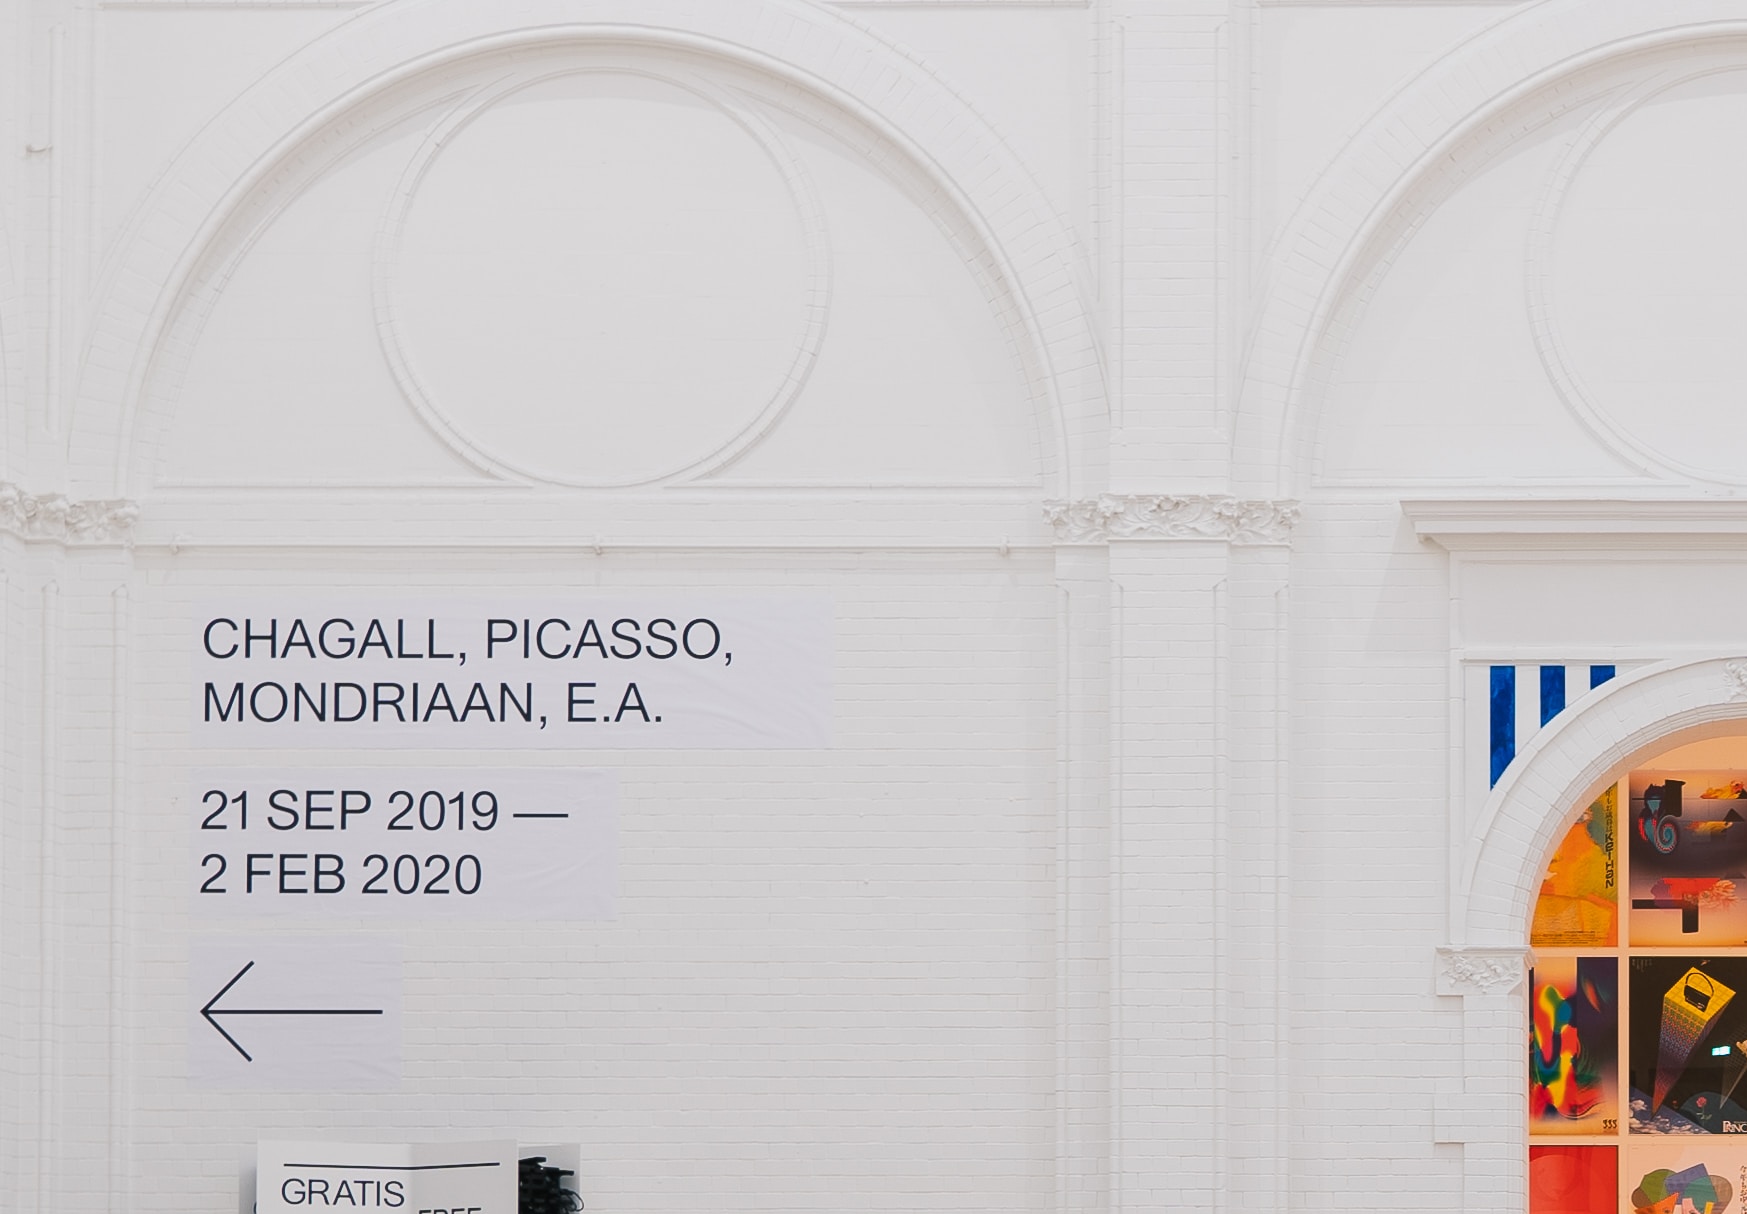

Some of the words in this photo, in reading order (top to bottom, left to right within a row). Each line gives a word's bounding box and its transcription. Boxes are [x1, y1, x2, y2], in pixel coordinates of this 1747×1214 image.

[203, 617, 466, 666] CHAGALL,
[487, 618, 732, 667] PICASSO,
[204, 681, 547, 730] MONDRIAAN,
[567, 682, 662, 723] E.A.
[200, 789, 247, 830] 21
[267, 789, 372, 831] SEP
[387, 790, 498, 831] 2019
[199, 853, 227, 894] 2
[246, 853, 346, 894] FEB
[361, 853, 482, 895] 2020
[281, 1178, 405, 1207] GRATIS
